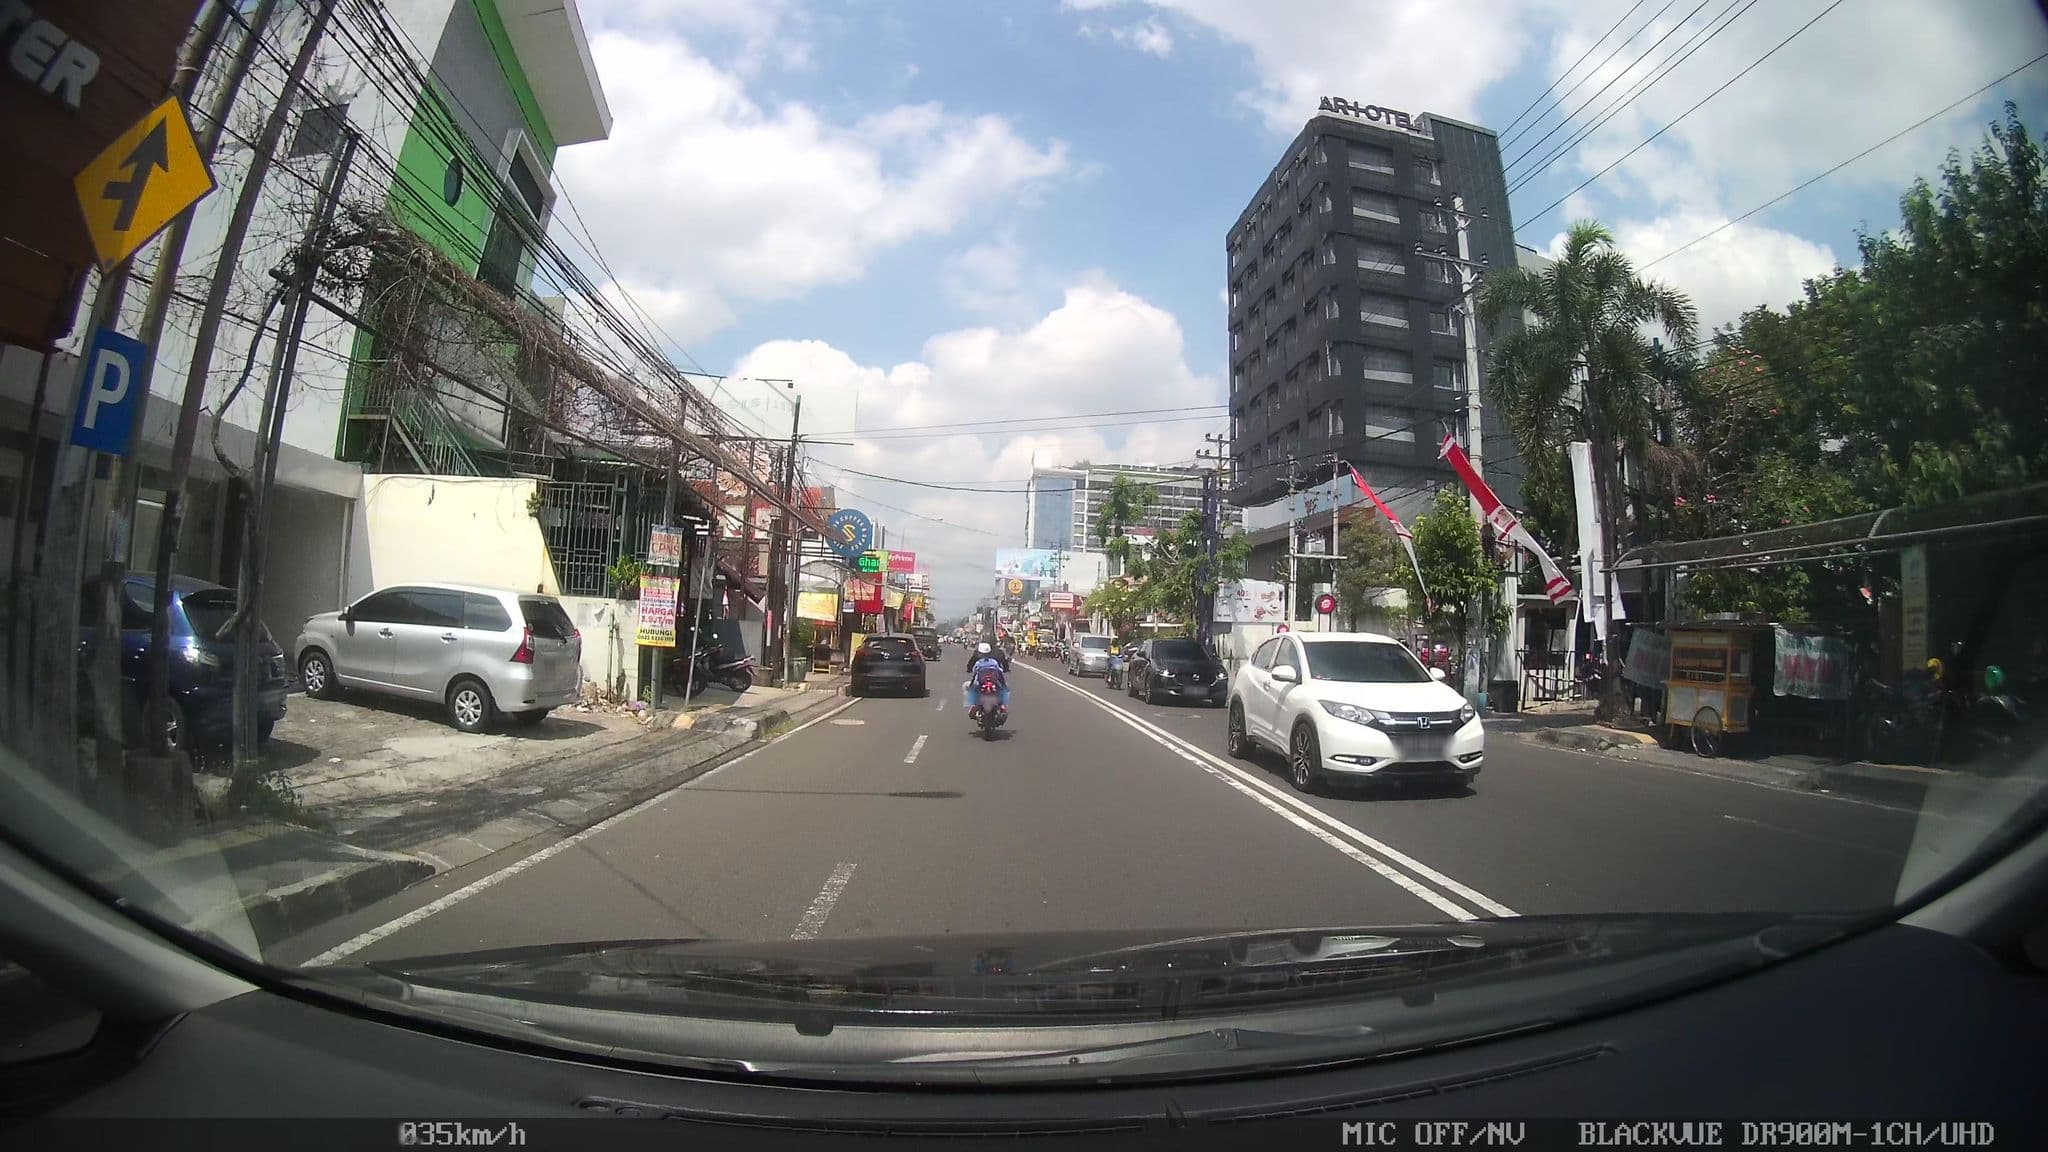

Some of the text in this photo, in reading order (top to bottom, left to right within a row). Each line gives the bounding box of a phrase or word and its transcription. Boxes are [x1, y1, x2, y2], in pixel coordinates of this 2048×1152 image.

[81, 347, 131, 430] P
[641, 606, 674, 617] HARGA
[639, 628, 673, 637] HUBUNGI
